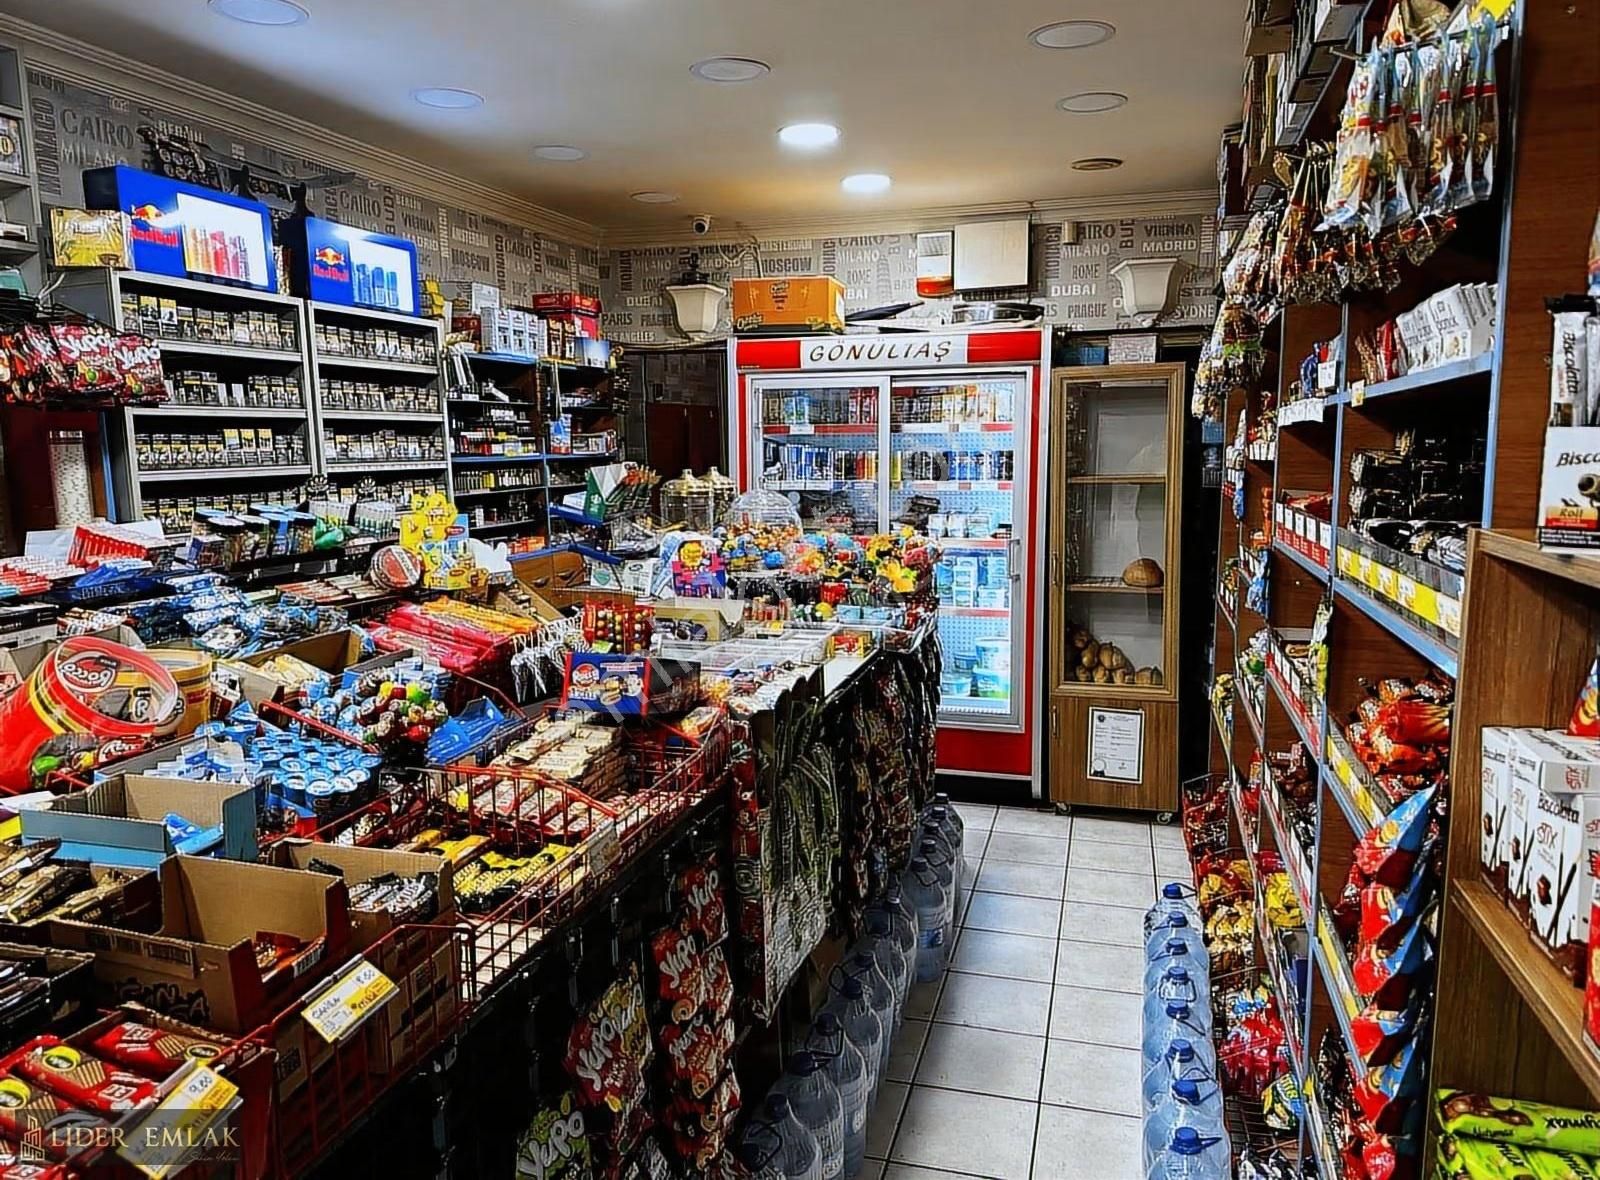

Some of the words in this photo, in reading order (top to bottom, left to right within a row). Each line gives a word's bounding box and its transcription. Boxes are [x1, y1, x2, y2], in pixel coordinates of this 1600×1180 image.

[62, 108, 134, 150] CAIRO
[32, 97, 62, 196] MONACO
[341, 190, 381, 218] CAIRO
[1144, 223, 1195, 237] VIENNA
[505, 239, 533, 259] CAIRO
[1061, 243, 1111, 259] MILANO
[1142, 239, 1197, 253] MADRID
[1051, 284, 1097, 297] DUBAI
[601, 312, 632, 326] PARIS
[1562, 330, 1581, 394] Biscolata
[659, 935, 697, 989] Yupo
[576, 1017, 616, 1092] Yupo
[517, 1110, 585, 1180] Yupo
